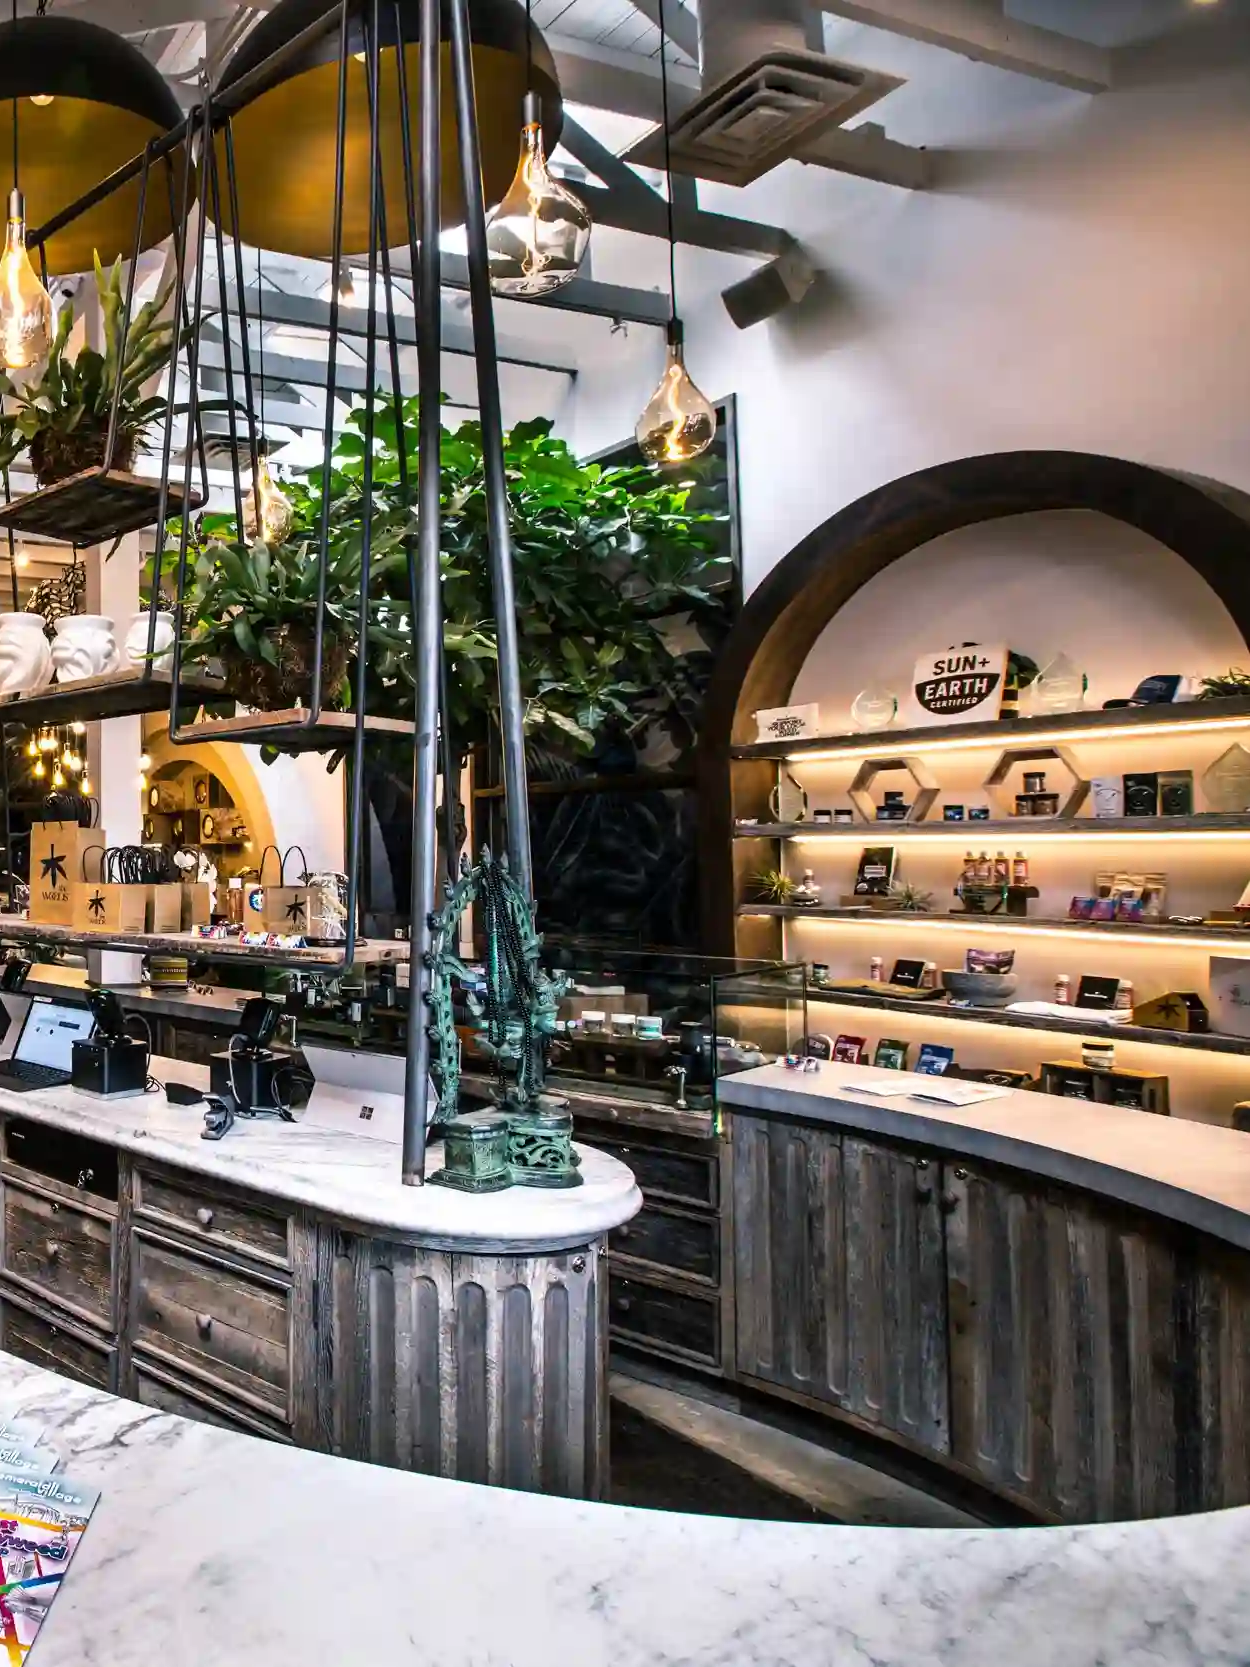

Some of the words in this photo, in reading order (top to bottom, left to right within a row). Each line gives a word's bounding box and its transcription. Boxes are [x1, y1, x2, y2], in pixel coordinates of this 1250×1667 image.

[933, 655, 990, 676] SUN+
[924, 678, 988, 701] EARTH
[930, 697, 979, 709] CERTIFIED
